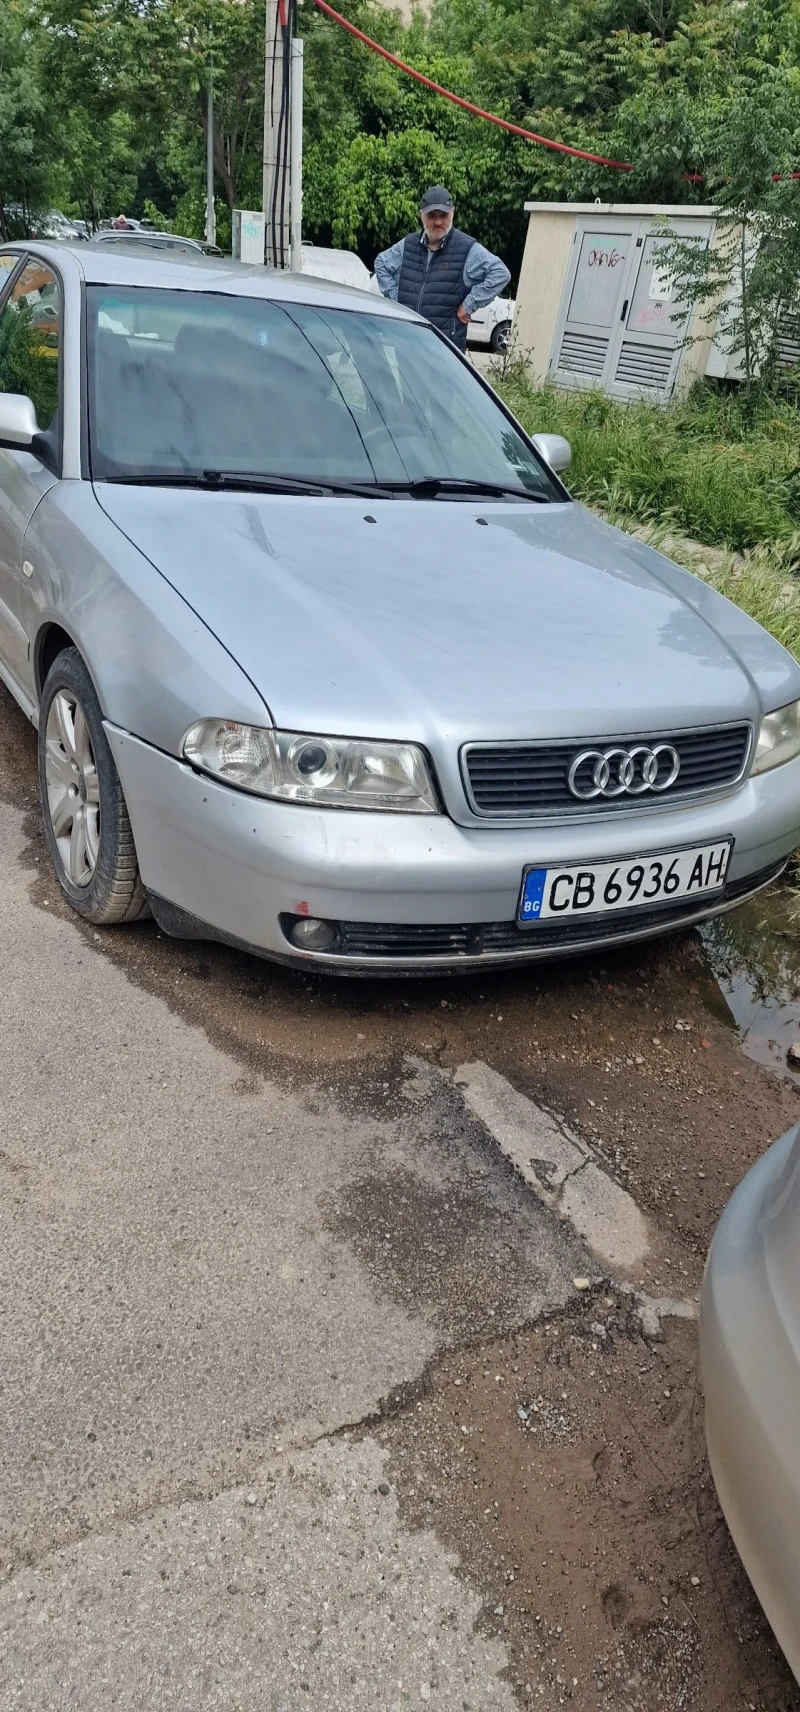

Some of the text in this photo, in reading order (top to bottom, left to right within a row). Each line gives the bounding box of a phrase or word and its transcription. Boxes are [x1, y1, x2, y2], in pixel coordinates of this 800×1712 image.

[549, 848, 726, 911] CB 6936 AH
[524, 900, 540, 912] BG
